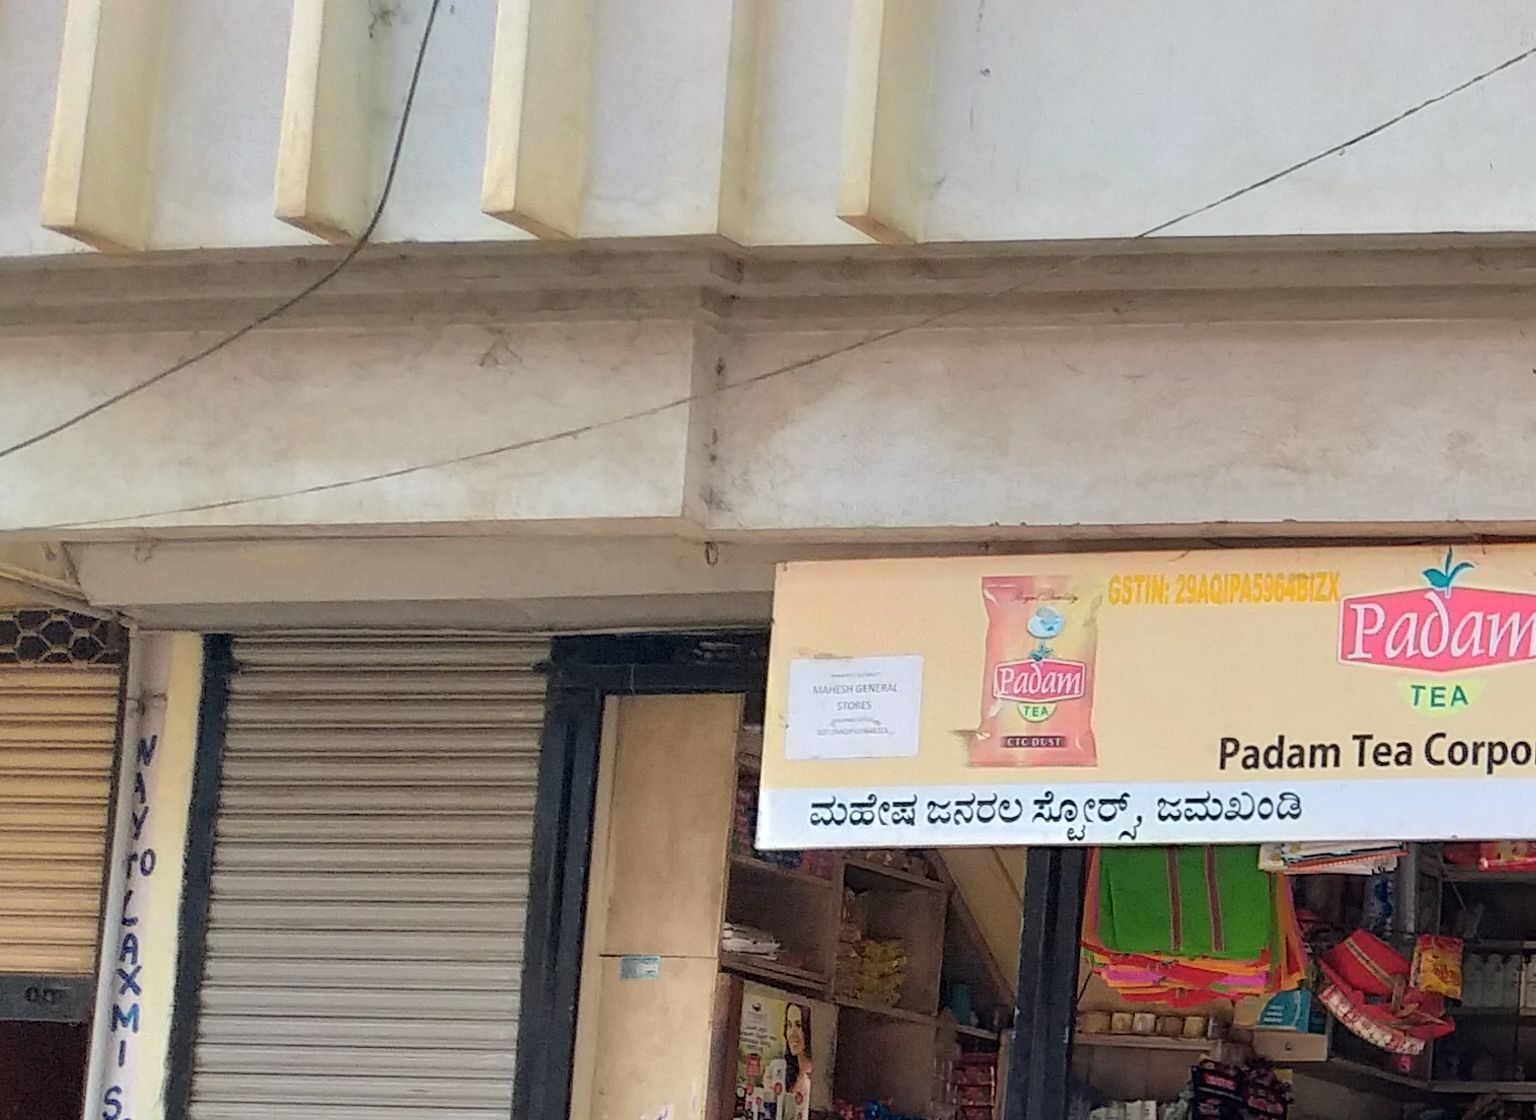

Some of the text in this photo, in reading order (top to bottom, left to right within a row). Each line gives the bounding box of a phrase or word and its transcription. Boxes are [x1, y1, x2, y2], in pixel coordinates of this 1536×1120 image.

[997, 661, 1083, 697] Padam
[812, 683, 898, 695] MAHESH GENERAL
[1410, 685, 1470, 708] TEA
[836, 701, 872, 711] STORES
[1023, 705, 1050, 718] TEA
[1032, 736, 1062, 748] DUST
[1219, 734, 1342, 770] Padam
[1352, 734, 1413, 768] Tea
[808, 792, 919, 828] ಮಹೇಷ
[926, 795, 1024, 826] ಜನರಲ
[1156, 789, 1304, 822] ಜಮಖಂಡಿ
